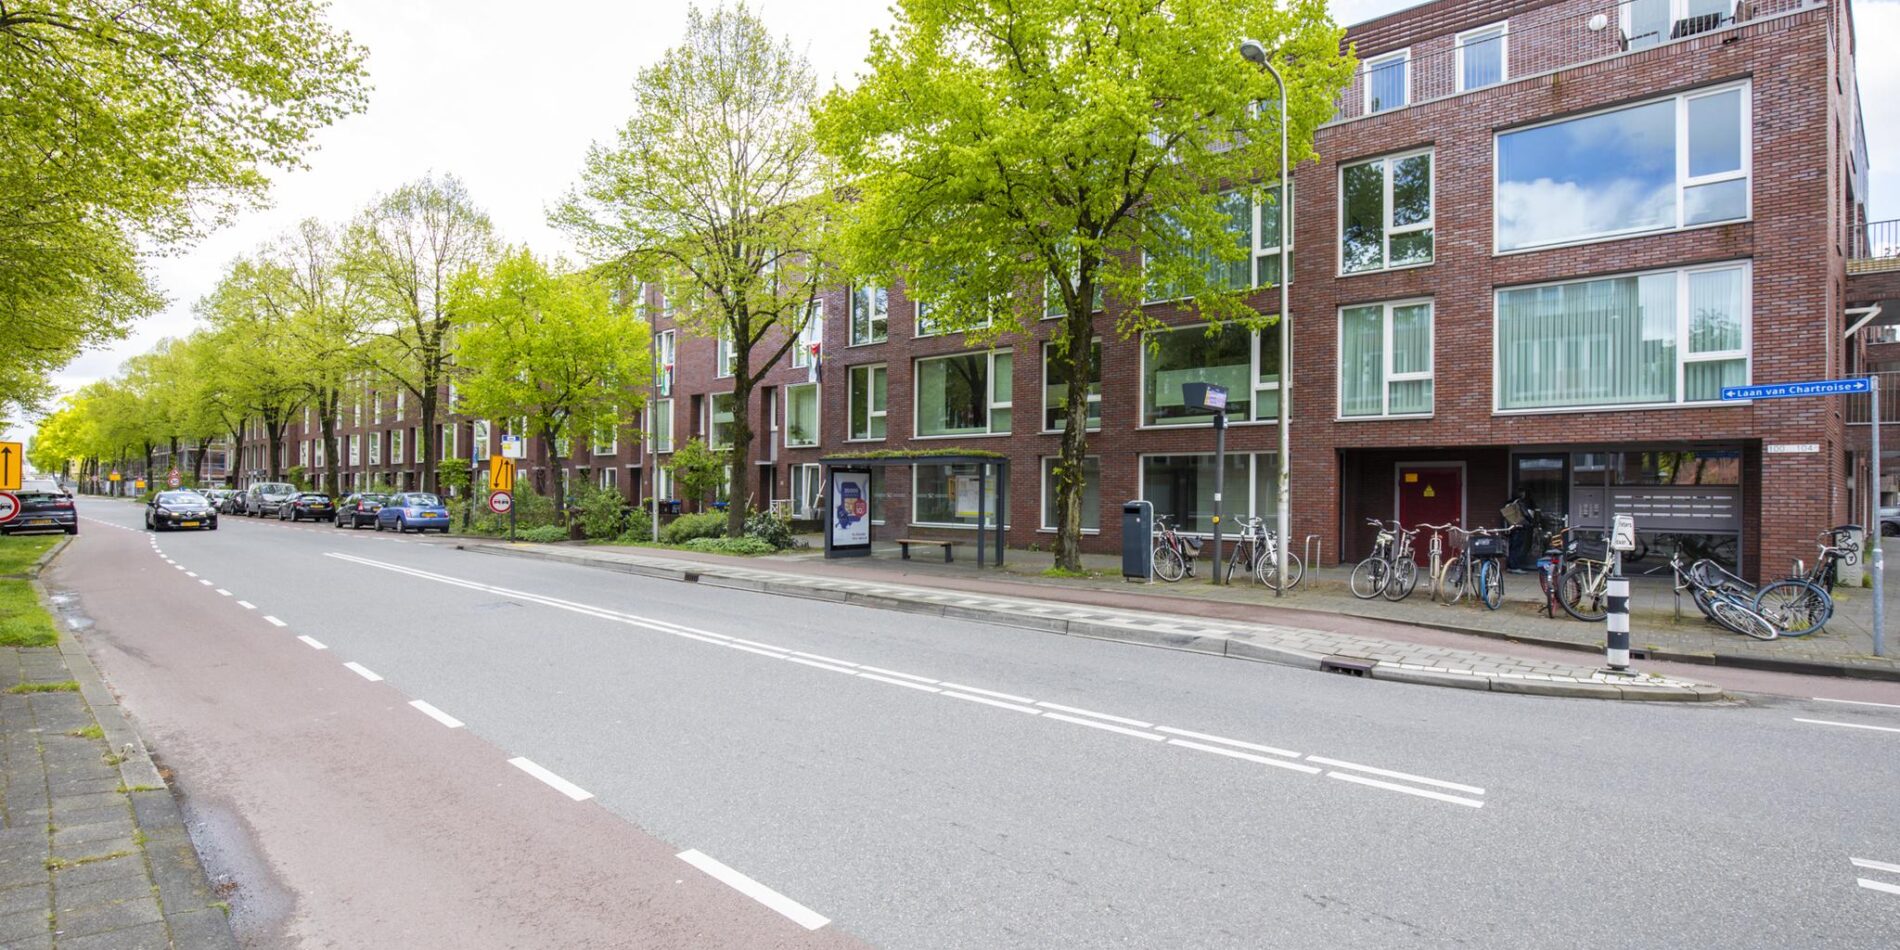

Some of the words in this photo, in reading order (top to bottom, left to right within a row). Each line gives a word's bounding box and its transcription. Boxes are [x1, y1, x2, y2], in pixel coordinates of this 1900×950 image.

[1737, 389, 1762, 397] Laan
[1789, 383, 1852, 394] Chartroise
[1769, 445, 1785, 453] 100
